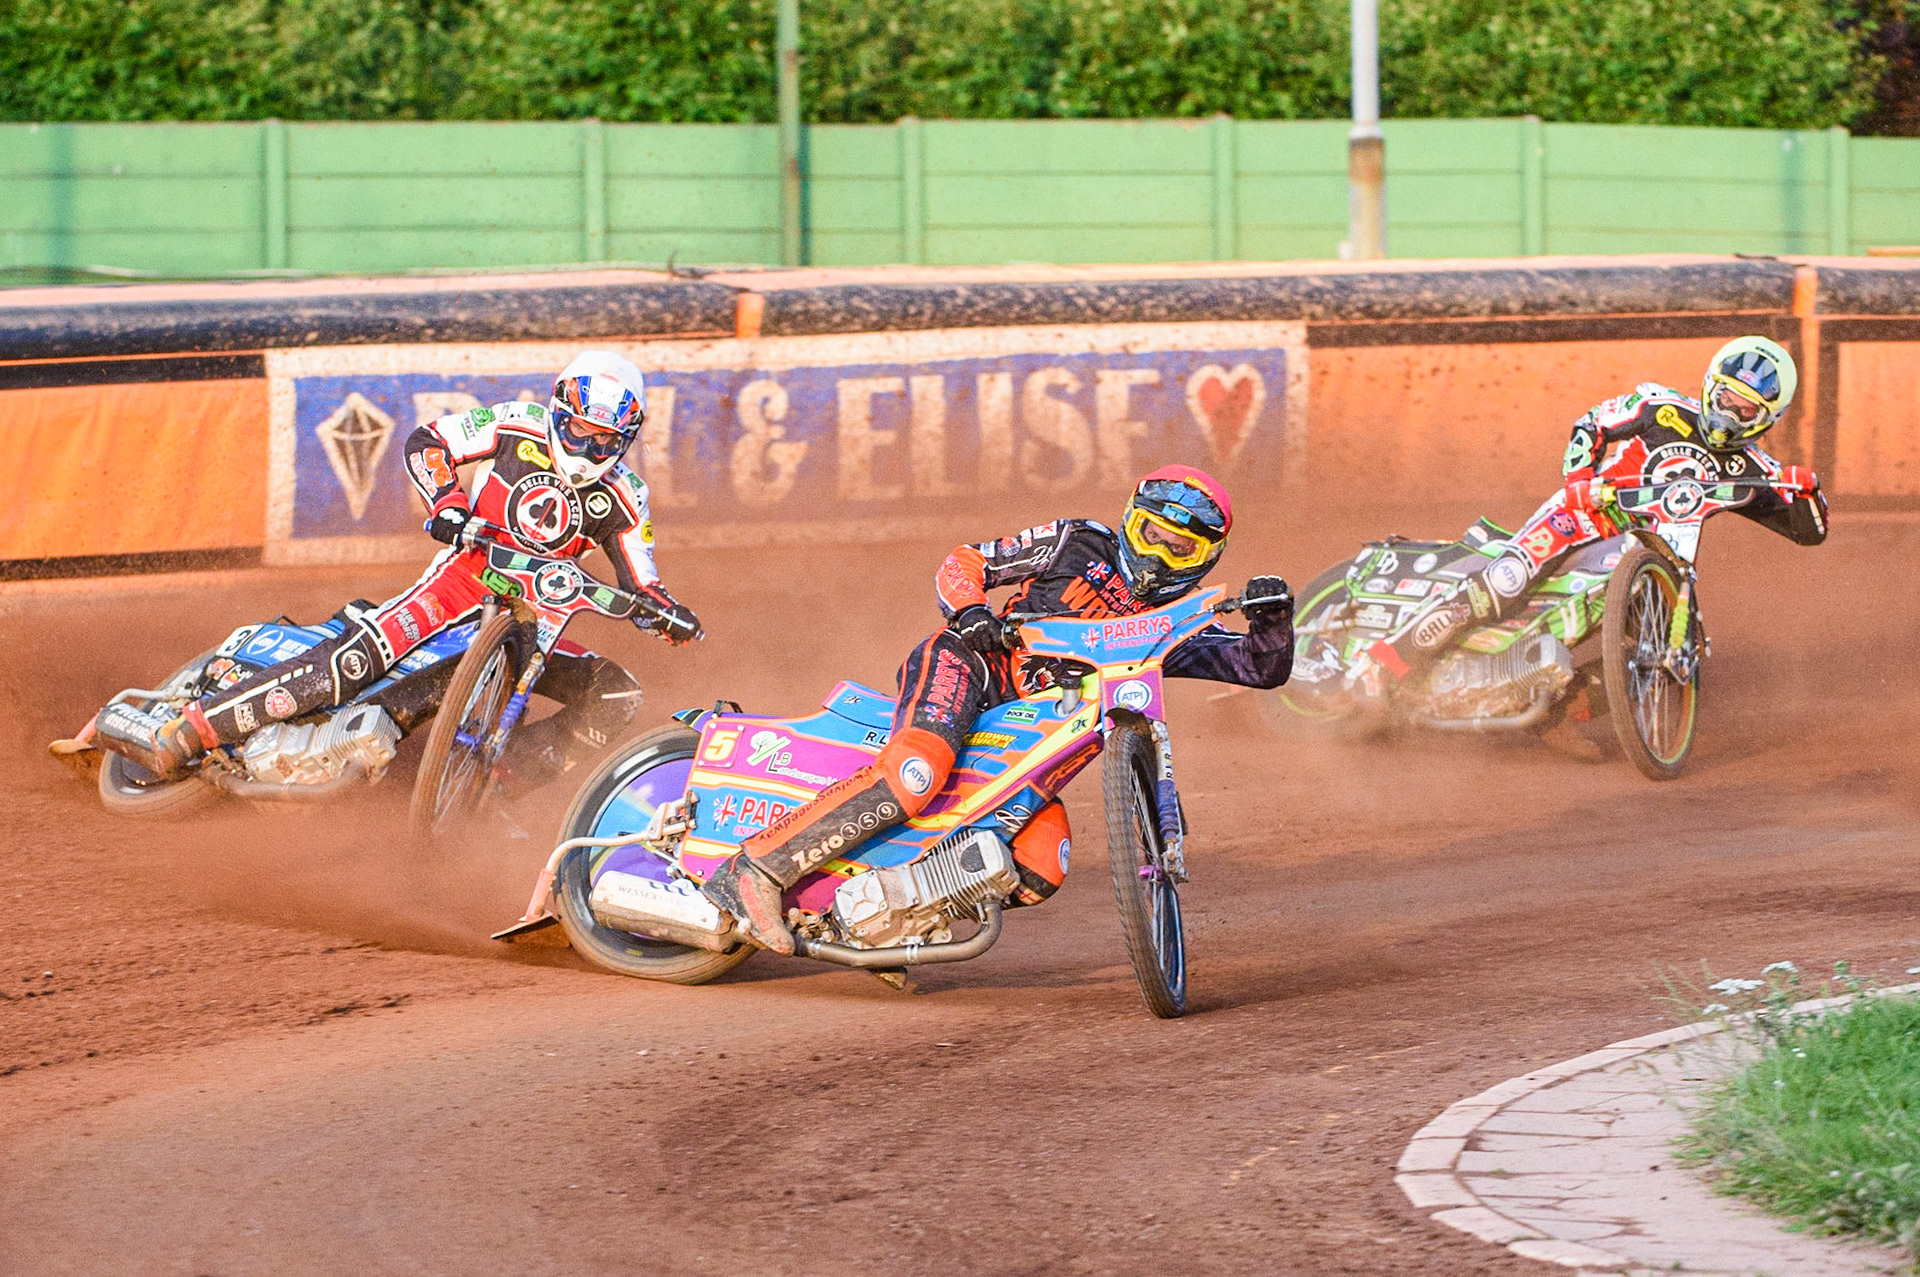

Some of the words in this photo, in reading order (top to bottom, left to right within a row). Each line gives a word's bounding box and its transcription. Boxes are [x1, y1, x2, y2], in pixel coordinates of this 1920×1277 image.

[1660, 447, 1692, 459] BELLE
[521, 477, 550, 492] BELLE
[554, 479, 572, 497] VUE
[569, 499, 579, 527] ACES
[1500, 564, 1518, 588] ATPI
[225, 629, 251, 652] 3
[1103, 616, 1172, 641] PARRYS
[924, 649, 963, 708] PARRYS
[1121, 690, 1144, 702] ATPI
[240, 703, 259, 730] NGK
[1006, 711, 1021, 719] ROCK
[704, 730, 739, 762] 5
[906, 766, 928, 787] ATPI
